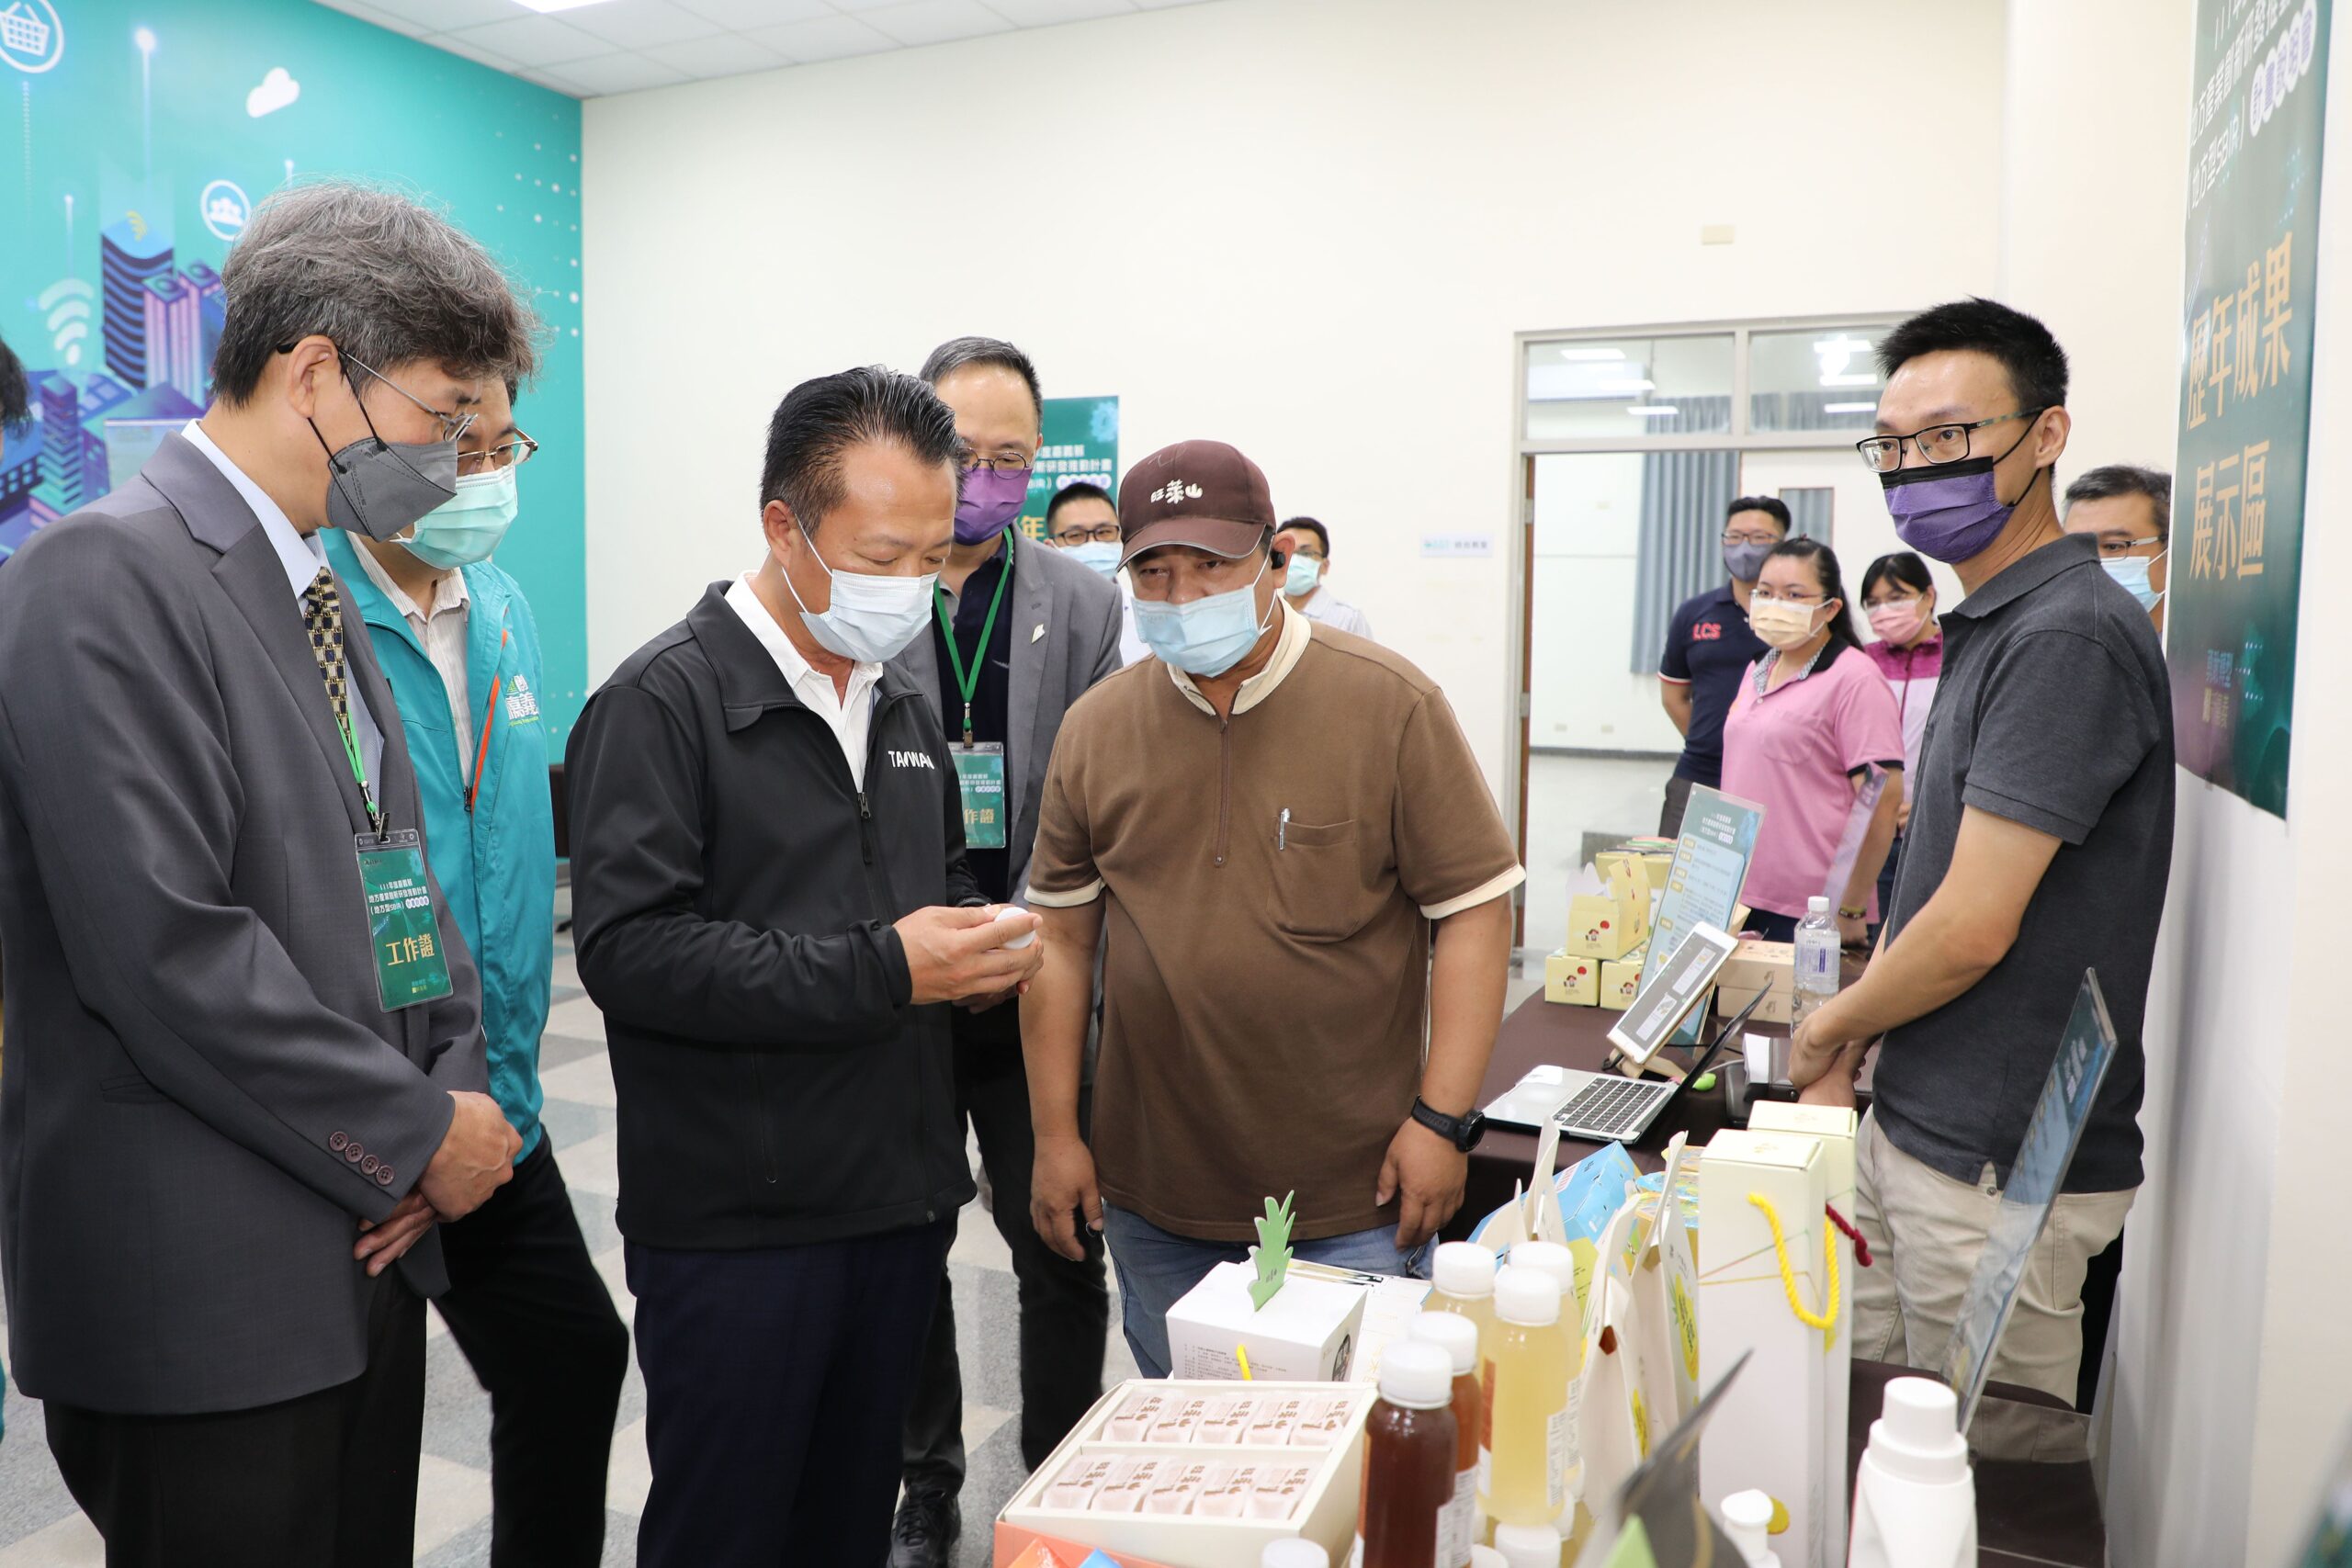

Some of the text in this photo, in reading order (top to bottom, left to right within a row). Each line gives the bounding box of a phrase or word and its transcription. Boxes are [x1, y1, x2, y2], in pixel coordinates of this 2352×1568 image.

[2187, 231, 2293, 432] 歷年成果
[2188, 439, 2270, 581] 展示區
[1693, 623, 1722, 640] LCS
[386, 933, 435, 966] 工作證
